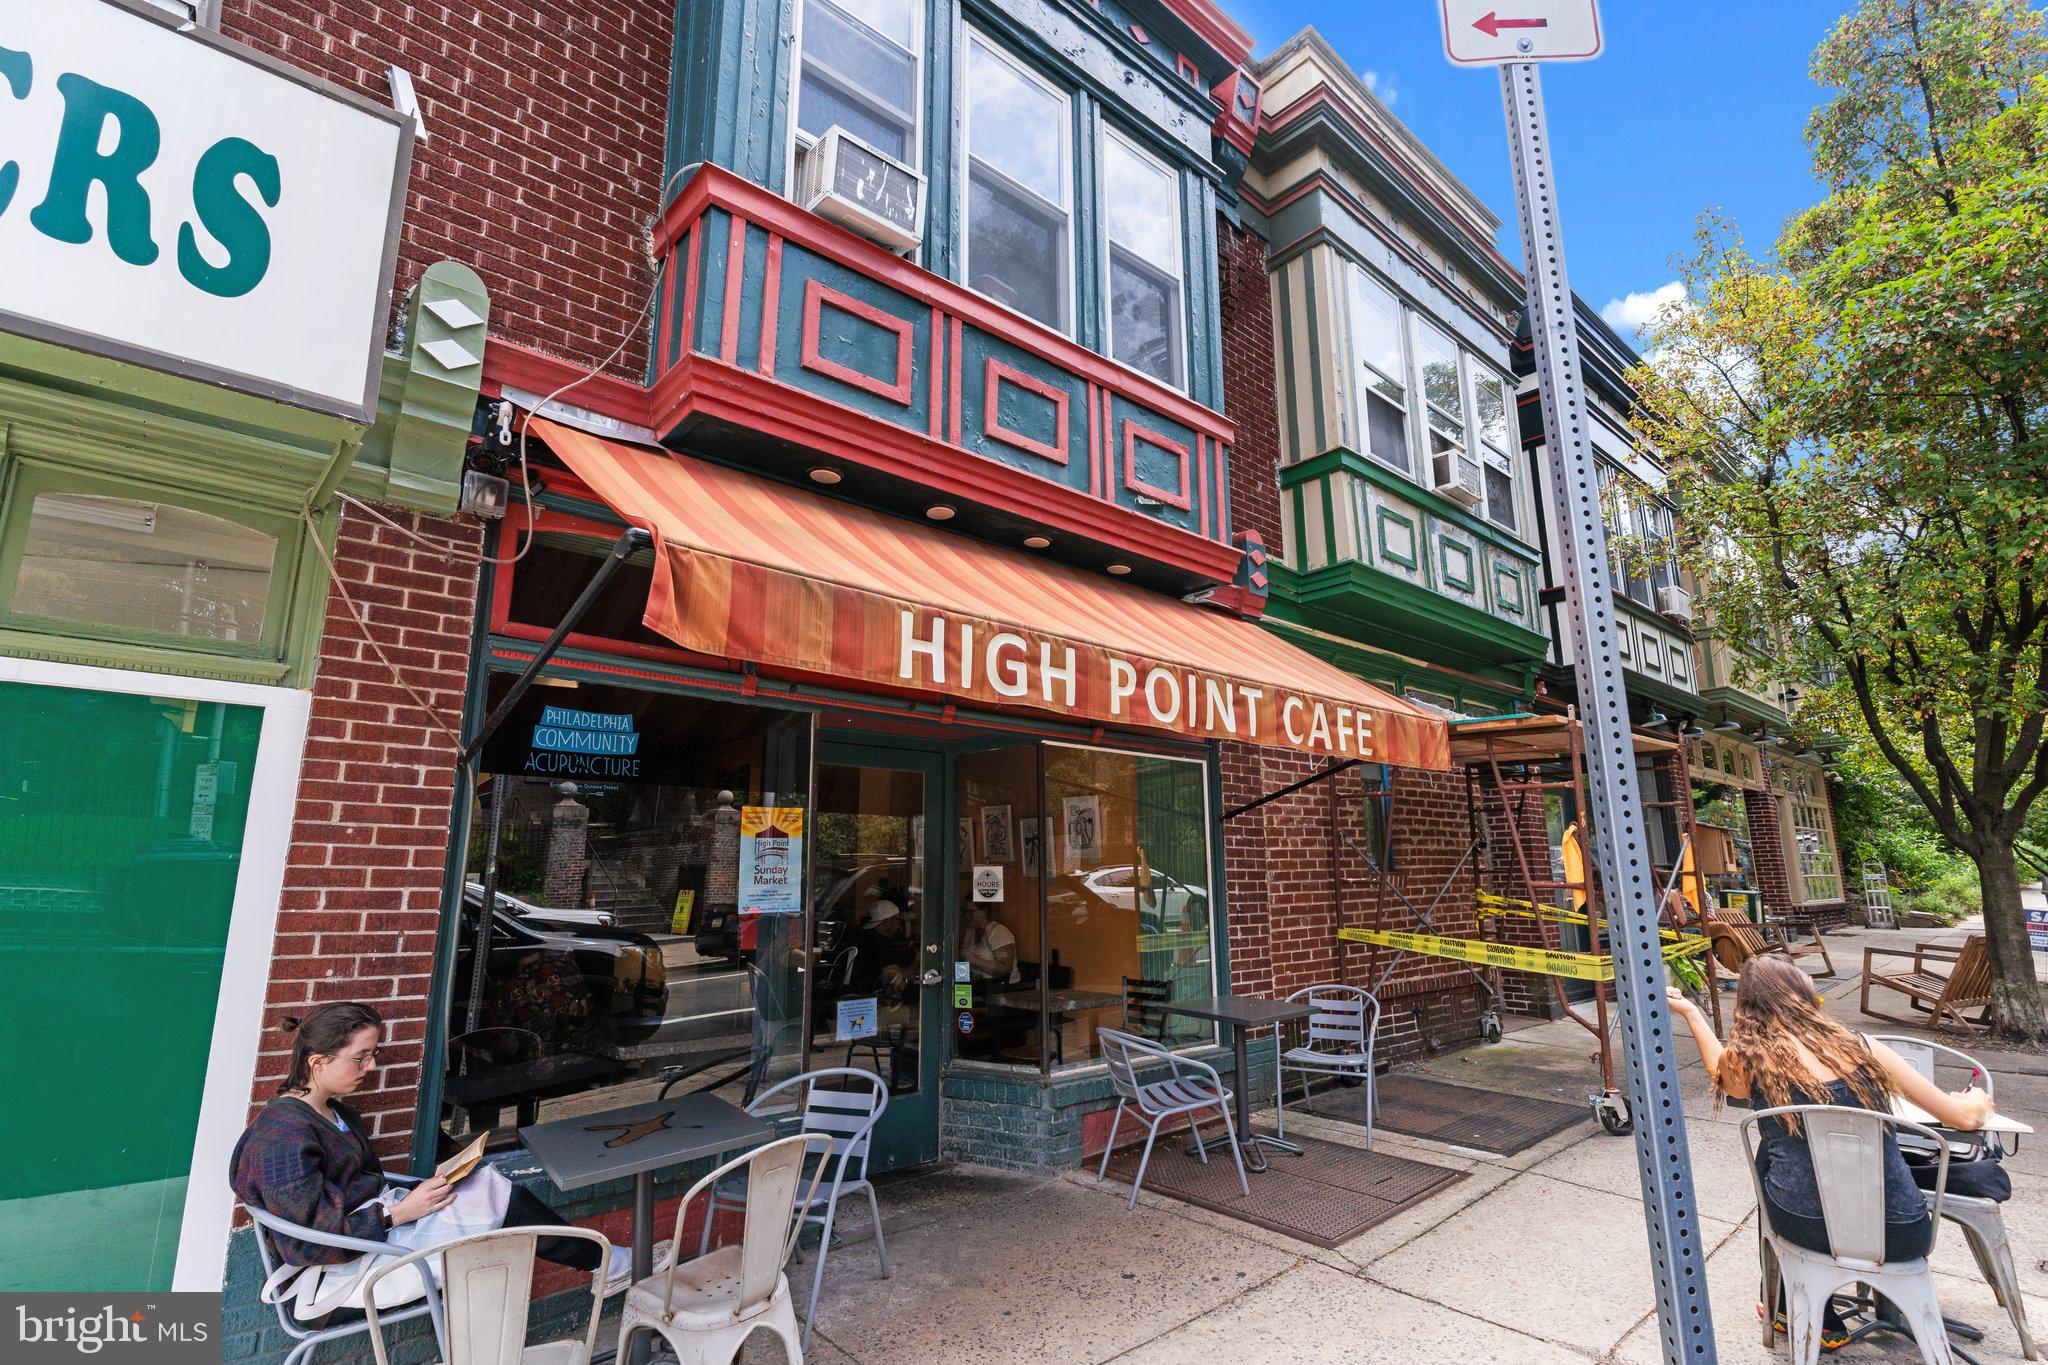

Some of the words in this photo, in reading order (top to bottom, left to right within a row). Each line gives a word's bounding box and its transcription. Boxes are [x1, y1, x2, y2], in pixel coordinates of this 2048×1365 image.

[900, 610, 1076, 707] HIGH
[1109, 658, 1263, 737] POINT
[1283, 696, 1373, 756] CAFE
[546, 709, 629, 731] PHILADELPHIA
[535, 728, 635, 753] COMMUNITY
[524, 751, 640, 777] ACUPUNCTURE
[772, 839, 789, 847] Point
[754, 864, 788, 876] Sunday
[753, 876, 788, 885] Market
[1486, 944, 1516, 955] CUIDADO
